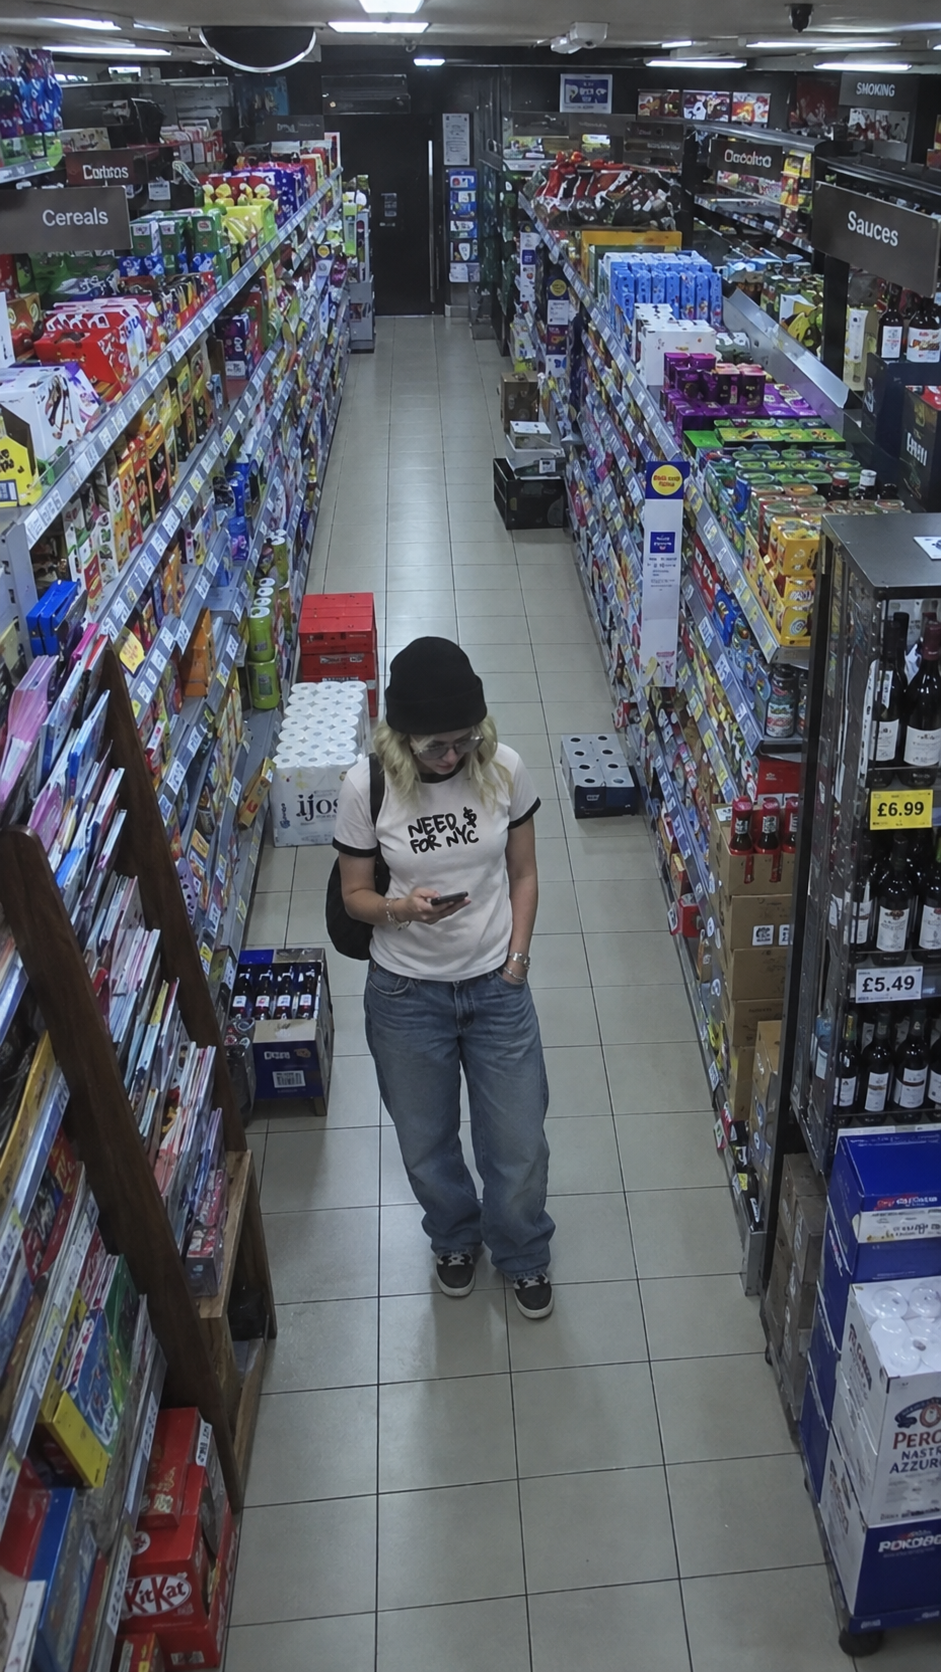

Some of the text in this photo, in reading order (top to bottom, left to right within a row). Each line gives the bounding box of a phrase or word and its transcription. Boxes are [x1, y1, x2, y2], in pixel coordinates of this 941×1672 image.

[856, 81, 896, 97] SMOKING
[42, 206, 109, 227] Cereals
[847, 210, 899, 247] Sauces
[877, 801, 924, 817] £6.99
[407, 813, 457, 838] NEED
[410, 824, 479, 854] FOR NYC
[862, 975, 915, 993] £5.49
[889, 1457, 941, 1474] AZZUR
